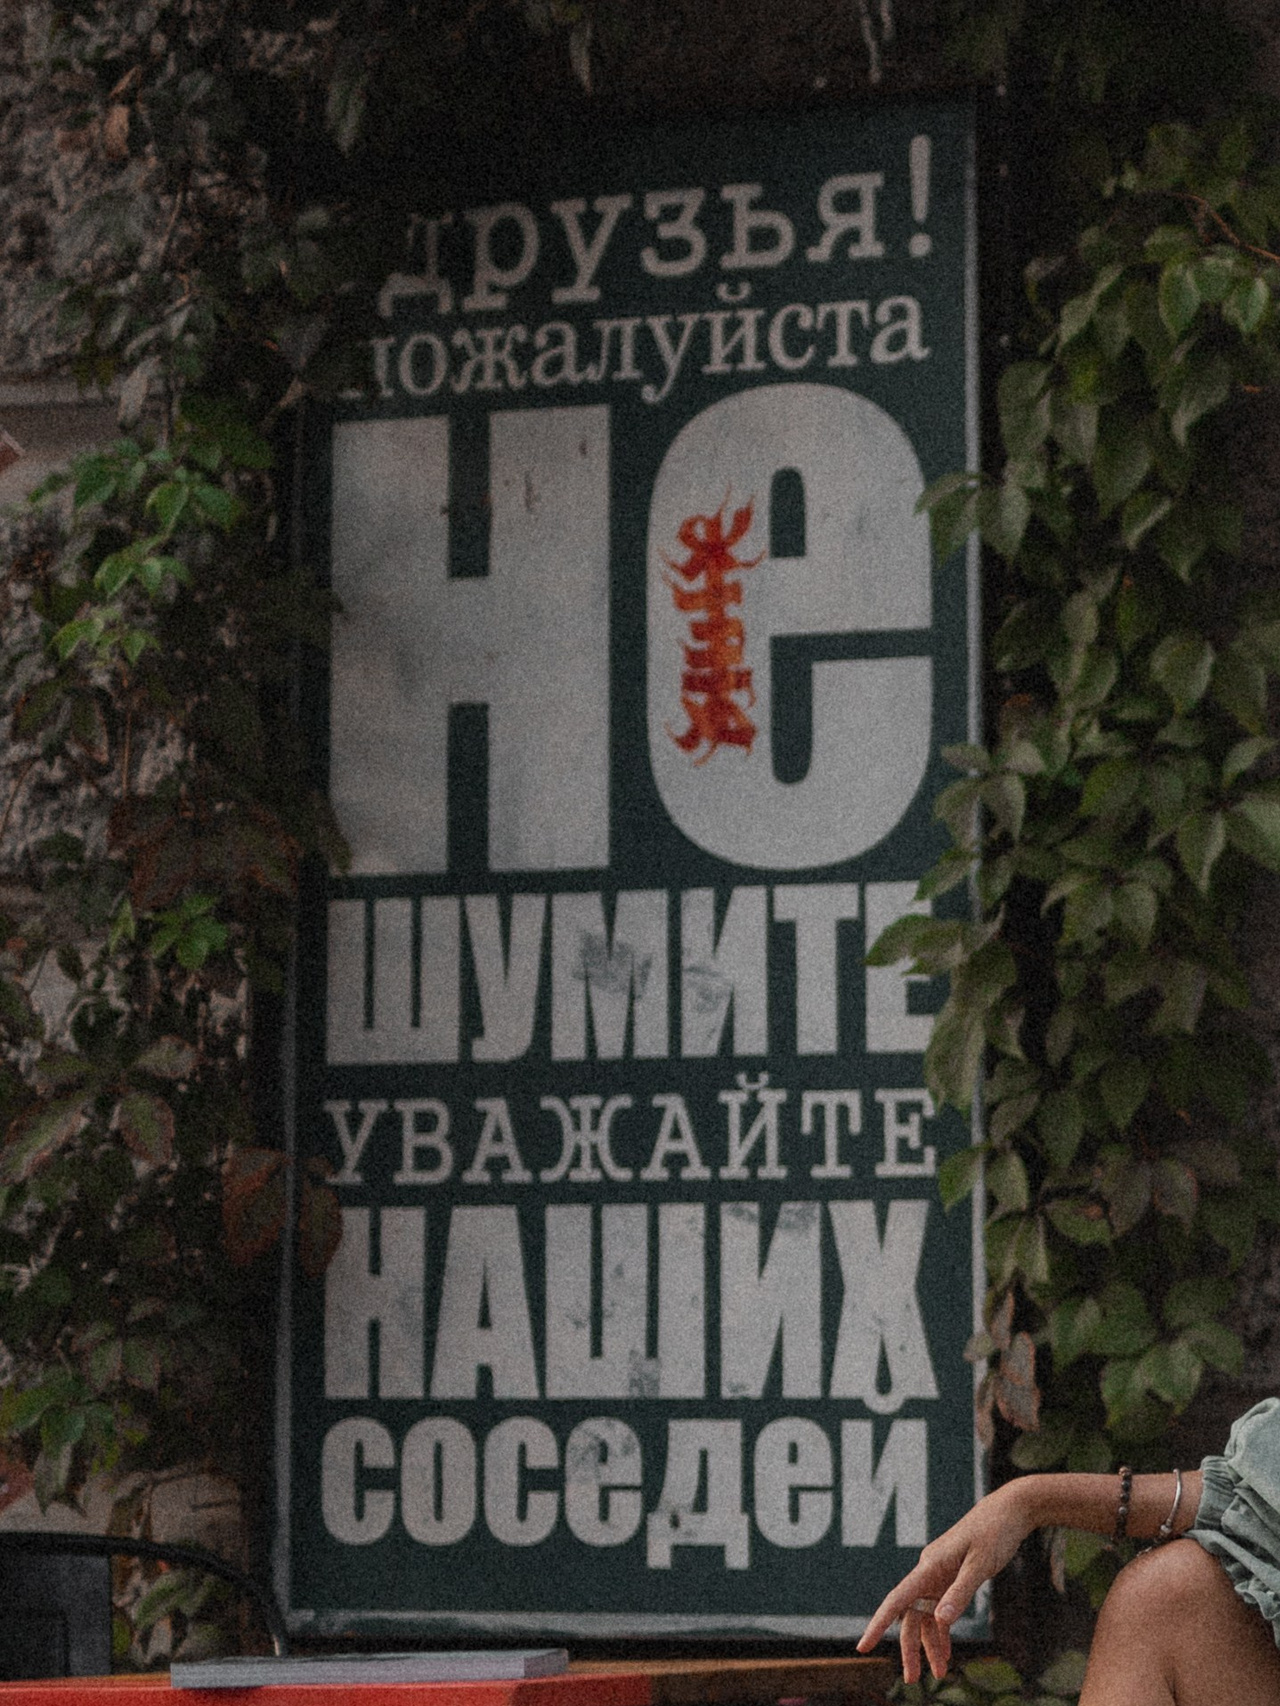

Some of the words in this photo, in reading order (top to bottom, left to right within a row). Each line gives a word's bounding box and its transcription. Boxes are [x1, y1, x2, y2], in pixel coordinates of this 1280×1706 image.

[377, 133, 934, 317] друзья!
[324, 1070, 937, 1186] УВАЖАЙТЕ
[325, 1199, 939, 1401] НАШИХ
[320, 1390, 927, 1570] соседей
